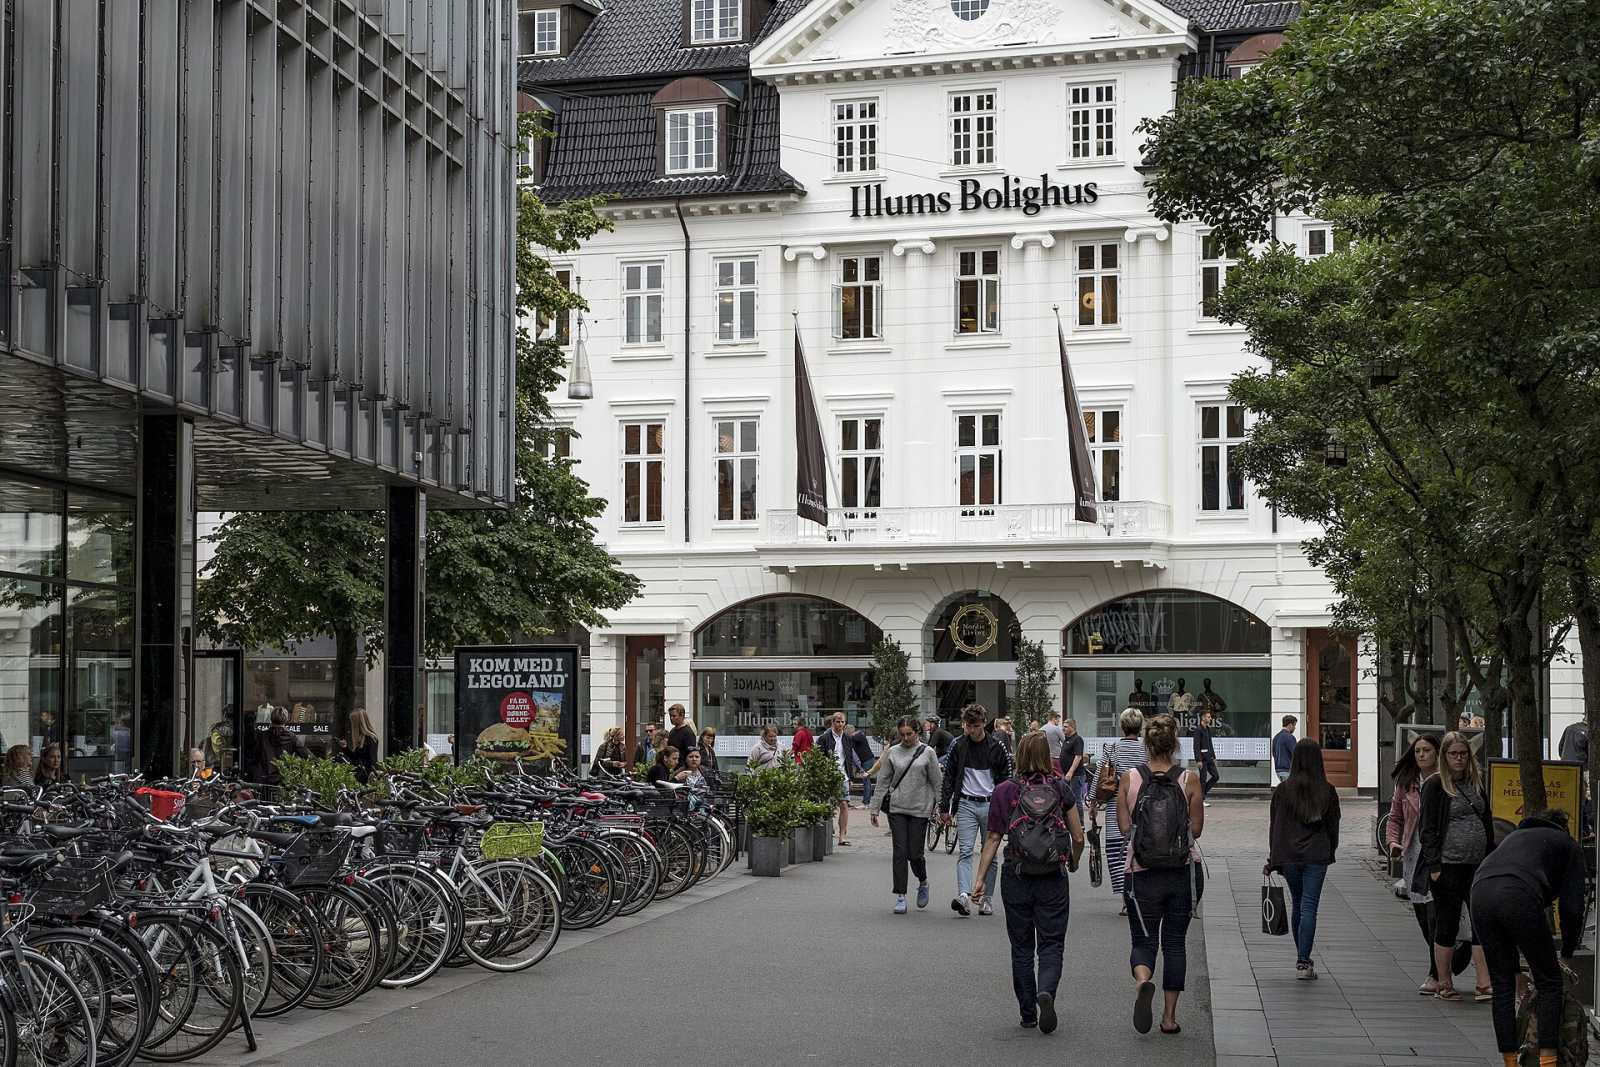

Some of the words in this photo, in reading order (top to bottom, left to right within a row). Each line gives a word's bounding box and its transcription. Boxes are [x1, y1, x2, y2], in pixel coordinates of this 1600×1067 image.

[849, 183, 952, 218] Illums
[958, 173, 1098, 216] Bolighus
[469, 658, 510, 672] KOM
[513, 658, 553, 672] MED
[555, 658, 563, 672] I
[737, 711, 780, 727] Illums
